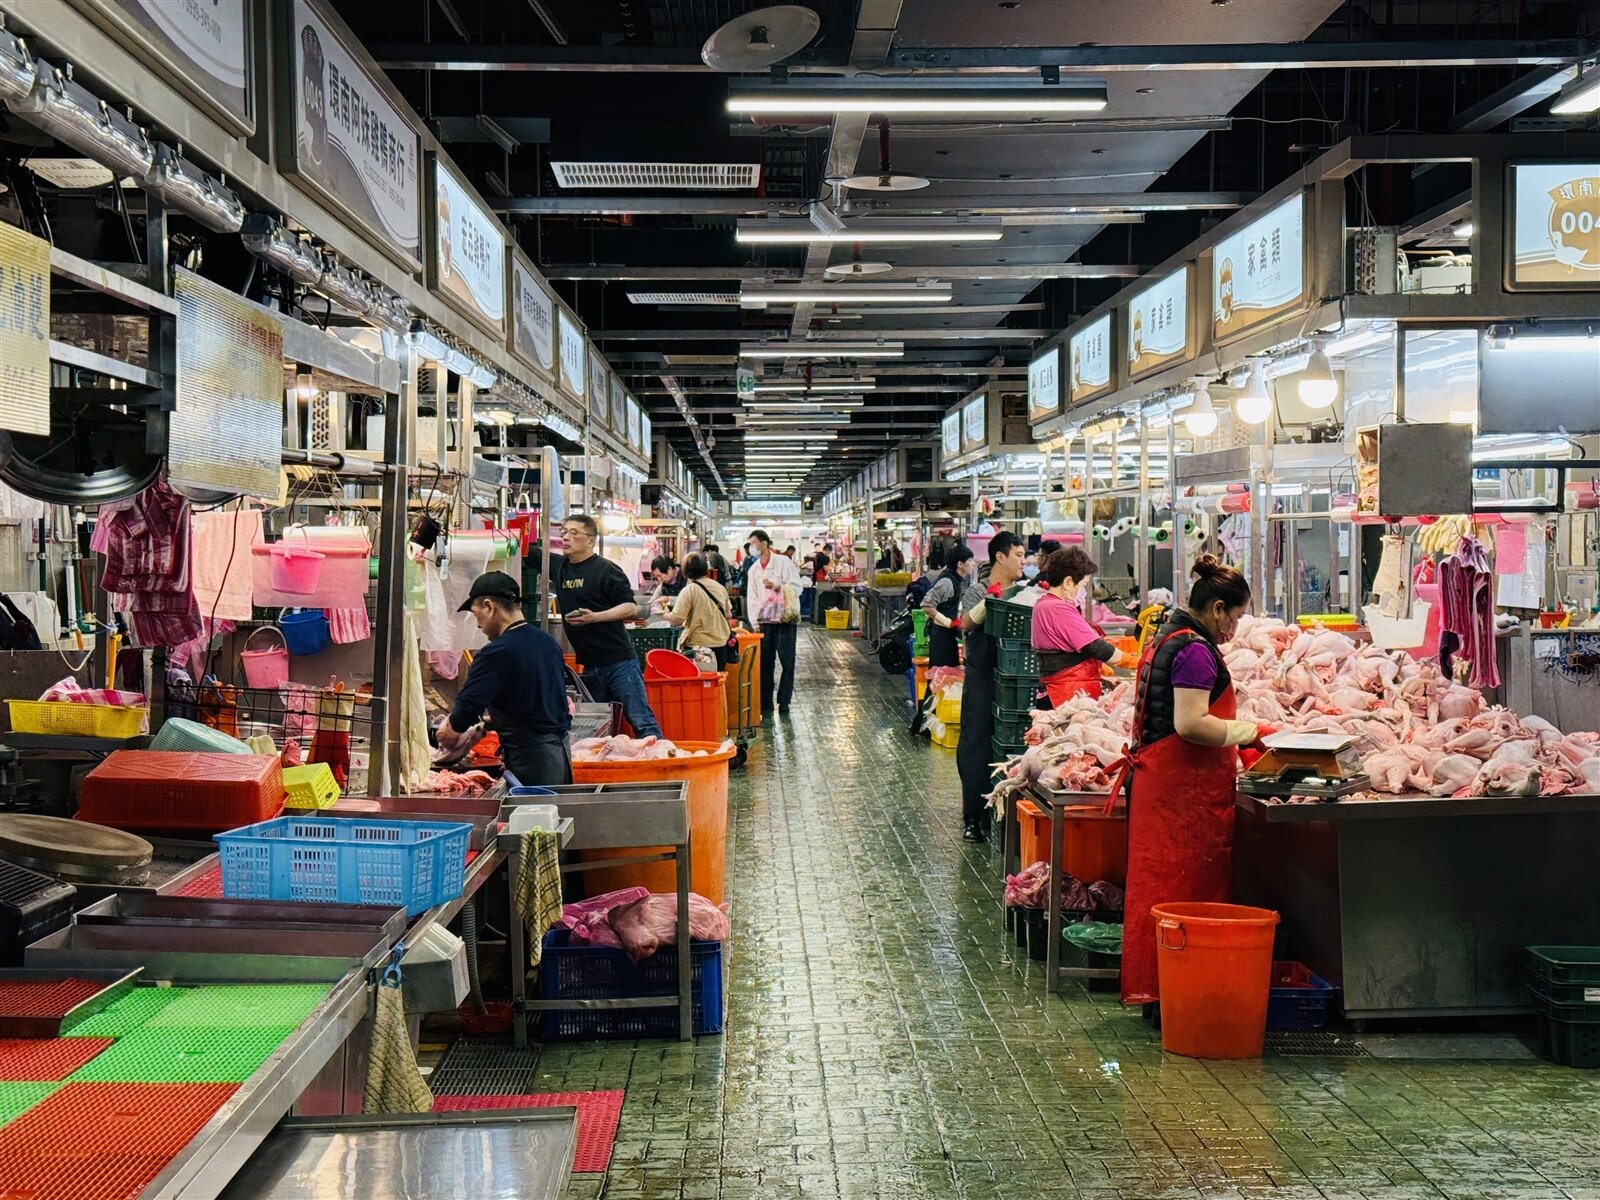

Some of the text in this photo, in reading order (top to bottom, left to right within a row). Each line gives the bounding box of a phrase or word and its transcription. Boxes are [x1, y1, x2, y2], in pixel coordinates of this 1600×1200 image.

[1559, 179, 1600, 200] 環南
[1248, 227, 1280, 278] 家禽類
